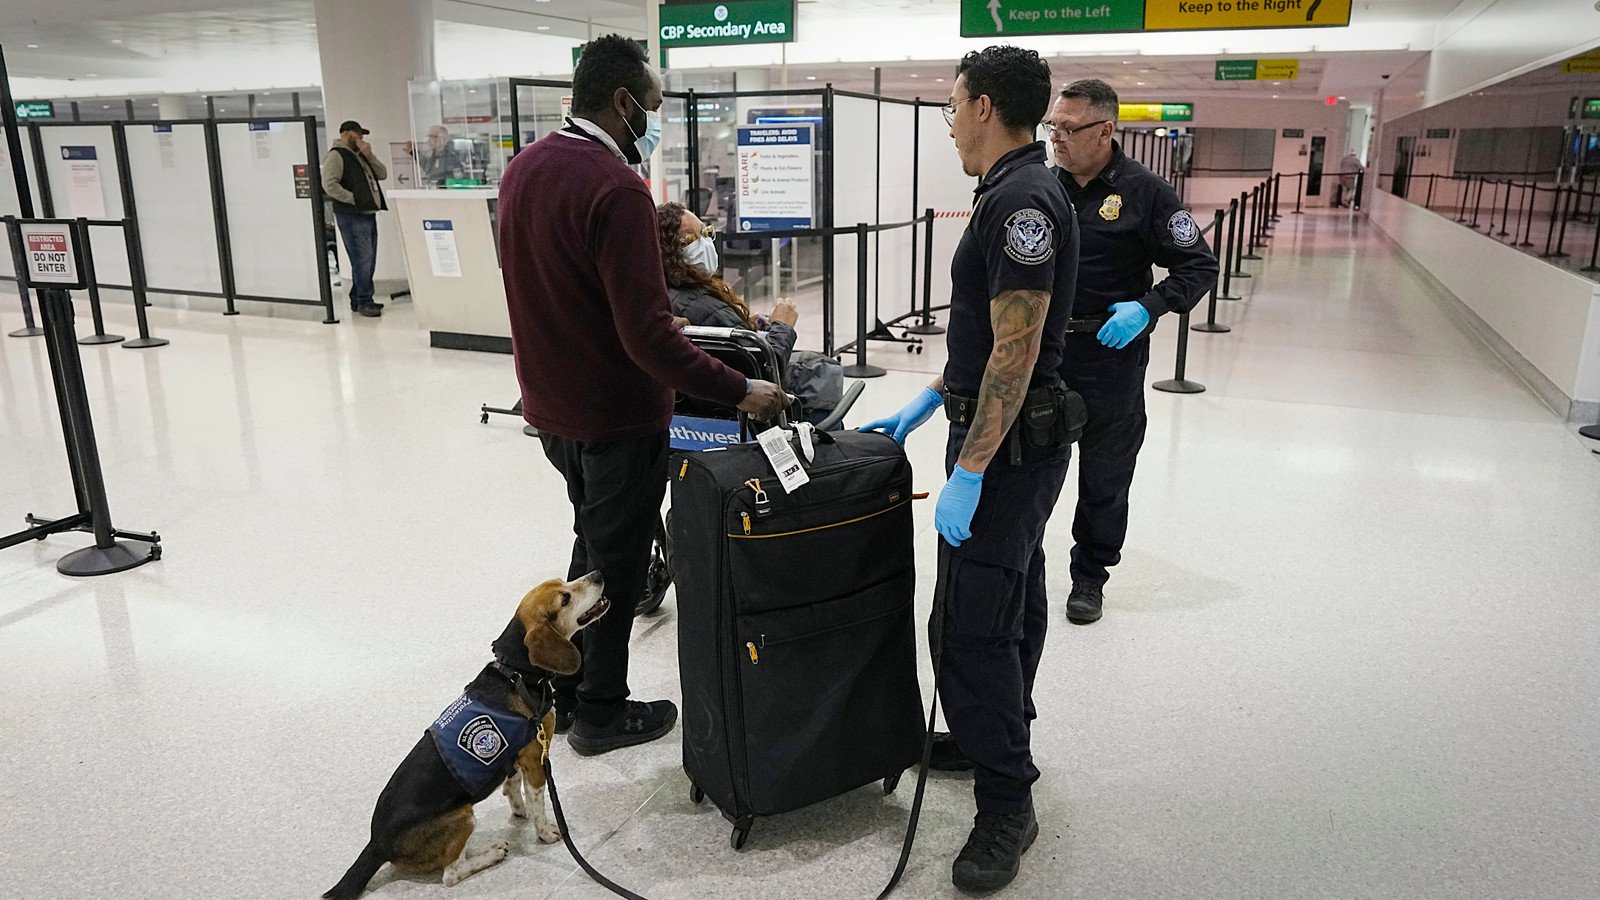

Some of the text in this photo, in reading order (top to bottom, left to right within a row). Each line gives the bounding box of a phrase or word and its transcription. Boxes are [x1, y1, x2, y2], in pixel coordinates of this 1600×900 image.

[1009, 6, 1111, 21] Keep to the Left
[1179, 0, 1301, 15] Keep to the Right
[660, 20, 786, 40] CBP Secondary Area
[741, 152, 750, 197] DECLARE
[34, 253, 66, 262] DO NOT
[37, 263, 66, 272] ENTER
